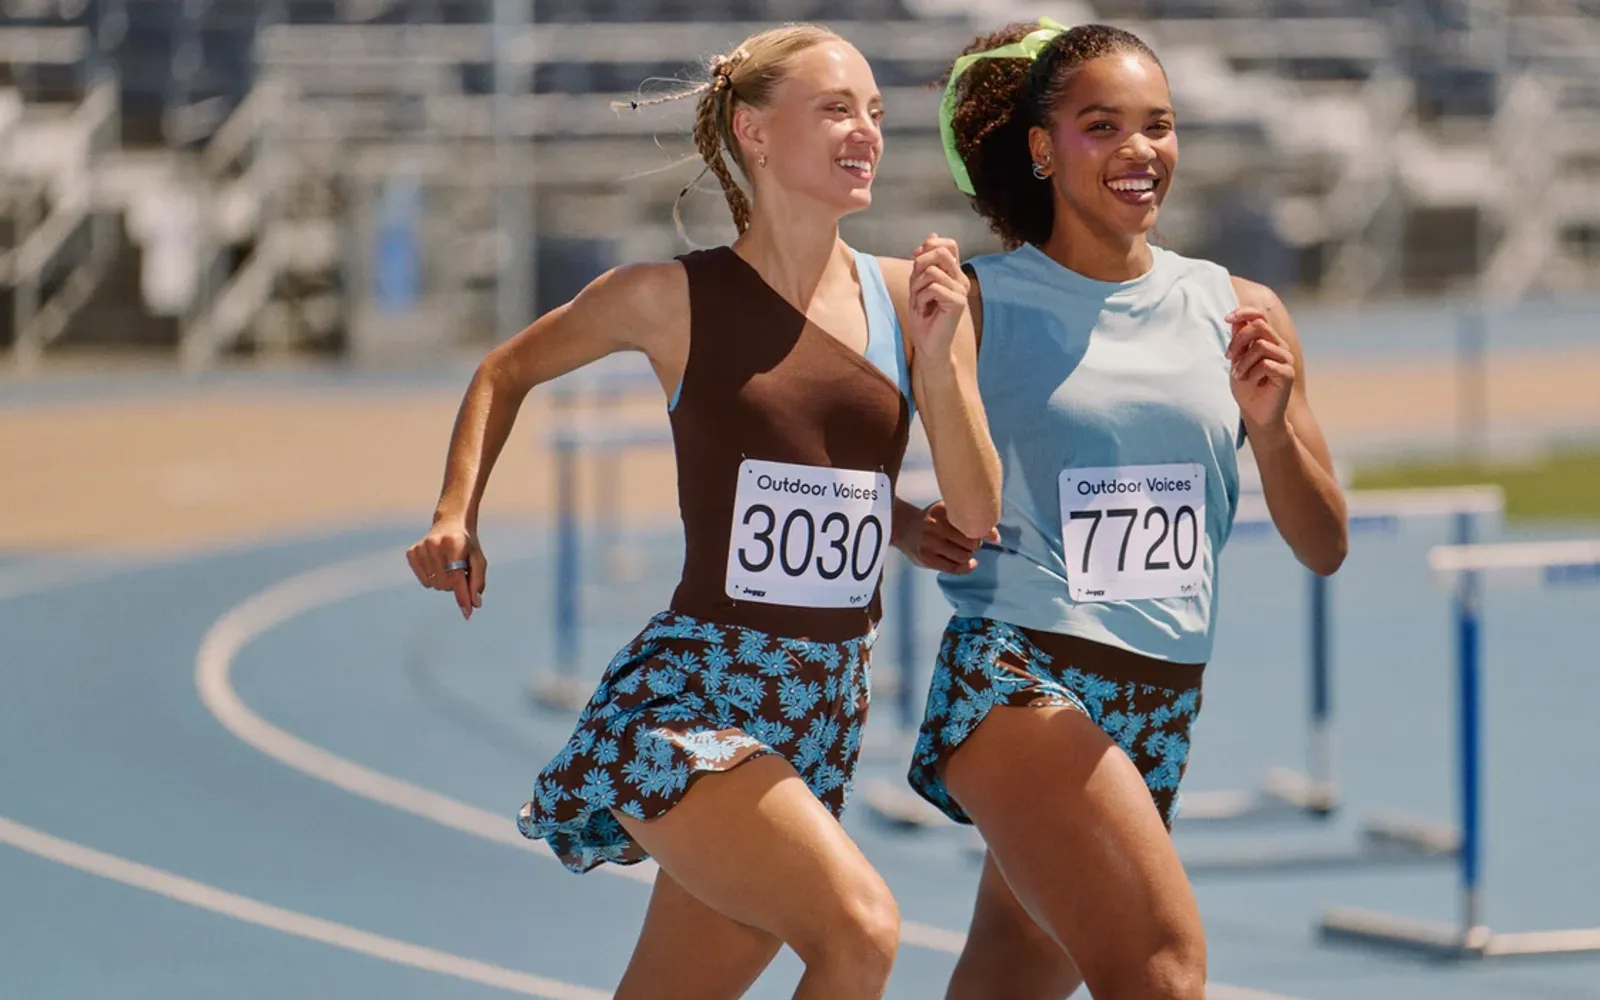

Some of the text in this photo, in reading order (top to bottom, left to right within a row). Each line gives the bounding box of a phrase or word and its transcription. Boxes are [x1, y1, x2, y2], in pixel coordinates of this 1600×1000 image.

[757, 474, 878, 501] Outdoor Voices
[1077, 477, 1191, 496] Outdoor Voices
[738, 504, 882, 581] 3030
[1069, 505, 1198, 573] 7720
